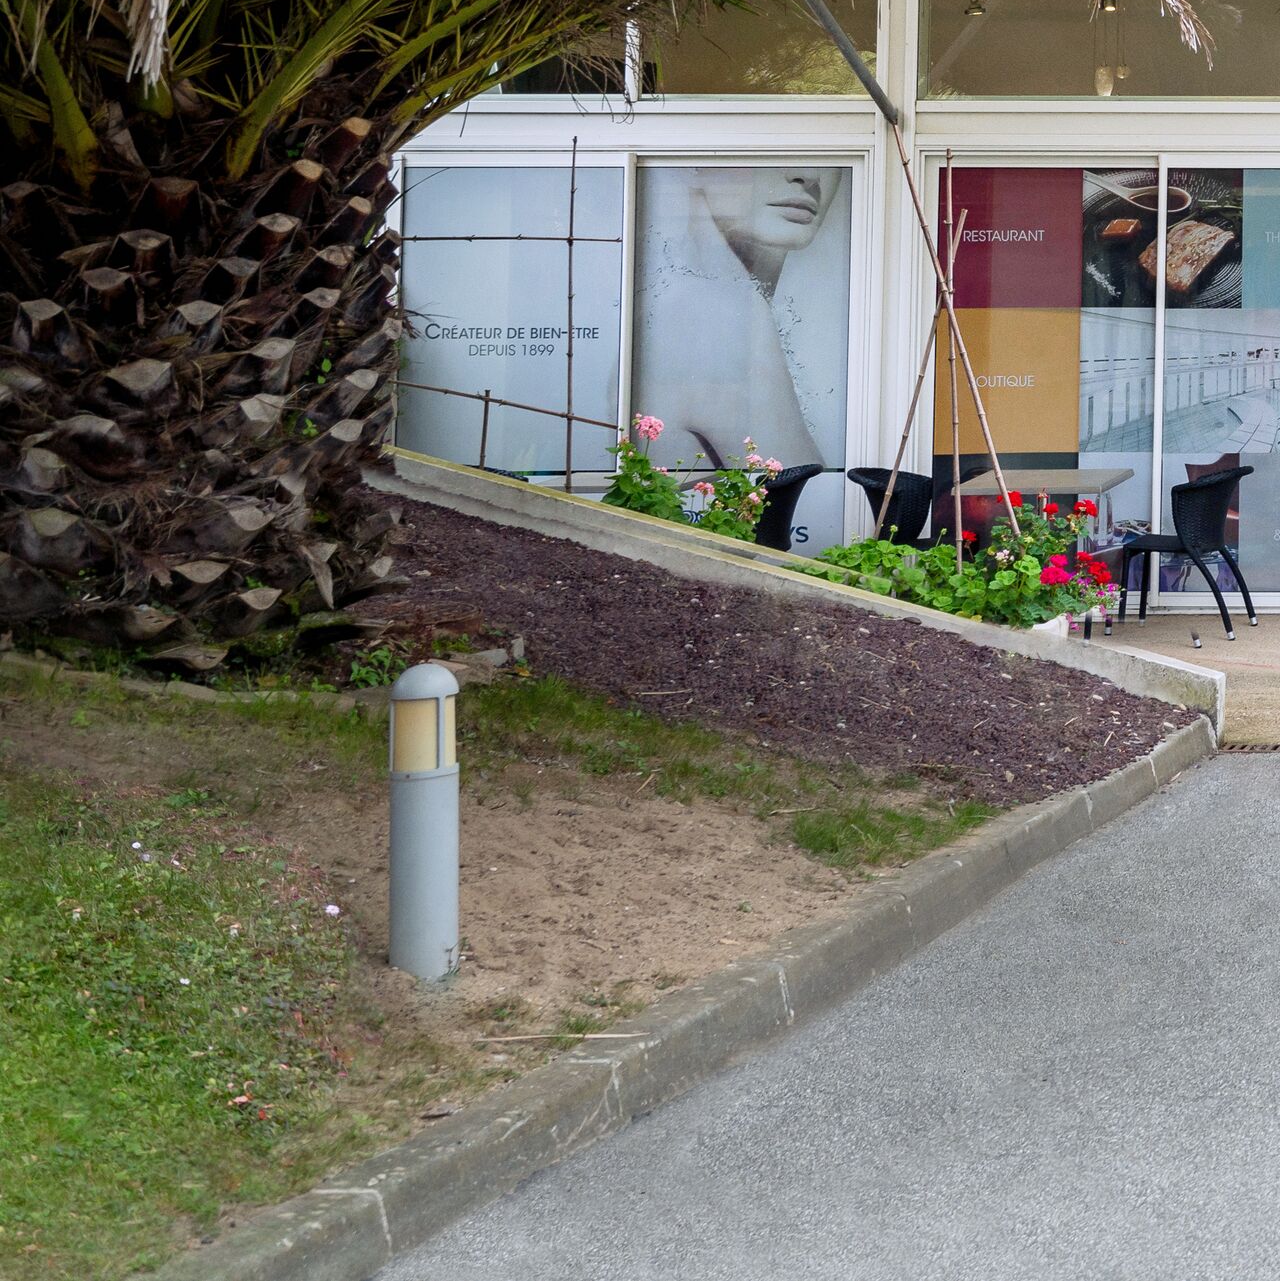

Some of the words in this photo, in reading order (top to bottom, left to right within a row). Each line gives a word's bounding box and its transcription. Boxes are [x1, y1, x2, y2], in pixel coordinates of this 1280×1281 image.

[963, 229, 1045, 242] RESTAURANT
[506, 327, 525, 339] DE
[468, 344, 517, 356] DEPUIS
[522, 344, 555, 356] 1899
[968, 375, 1035, 388] OUTIQUE
